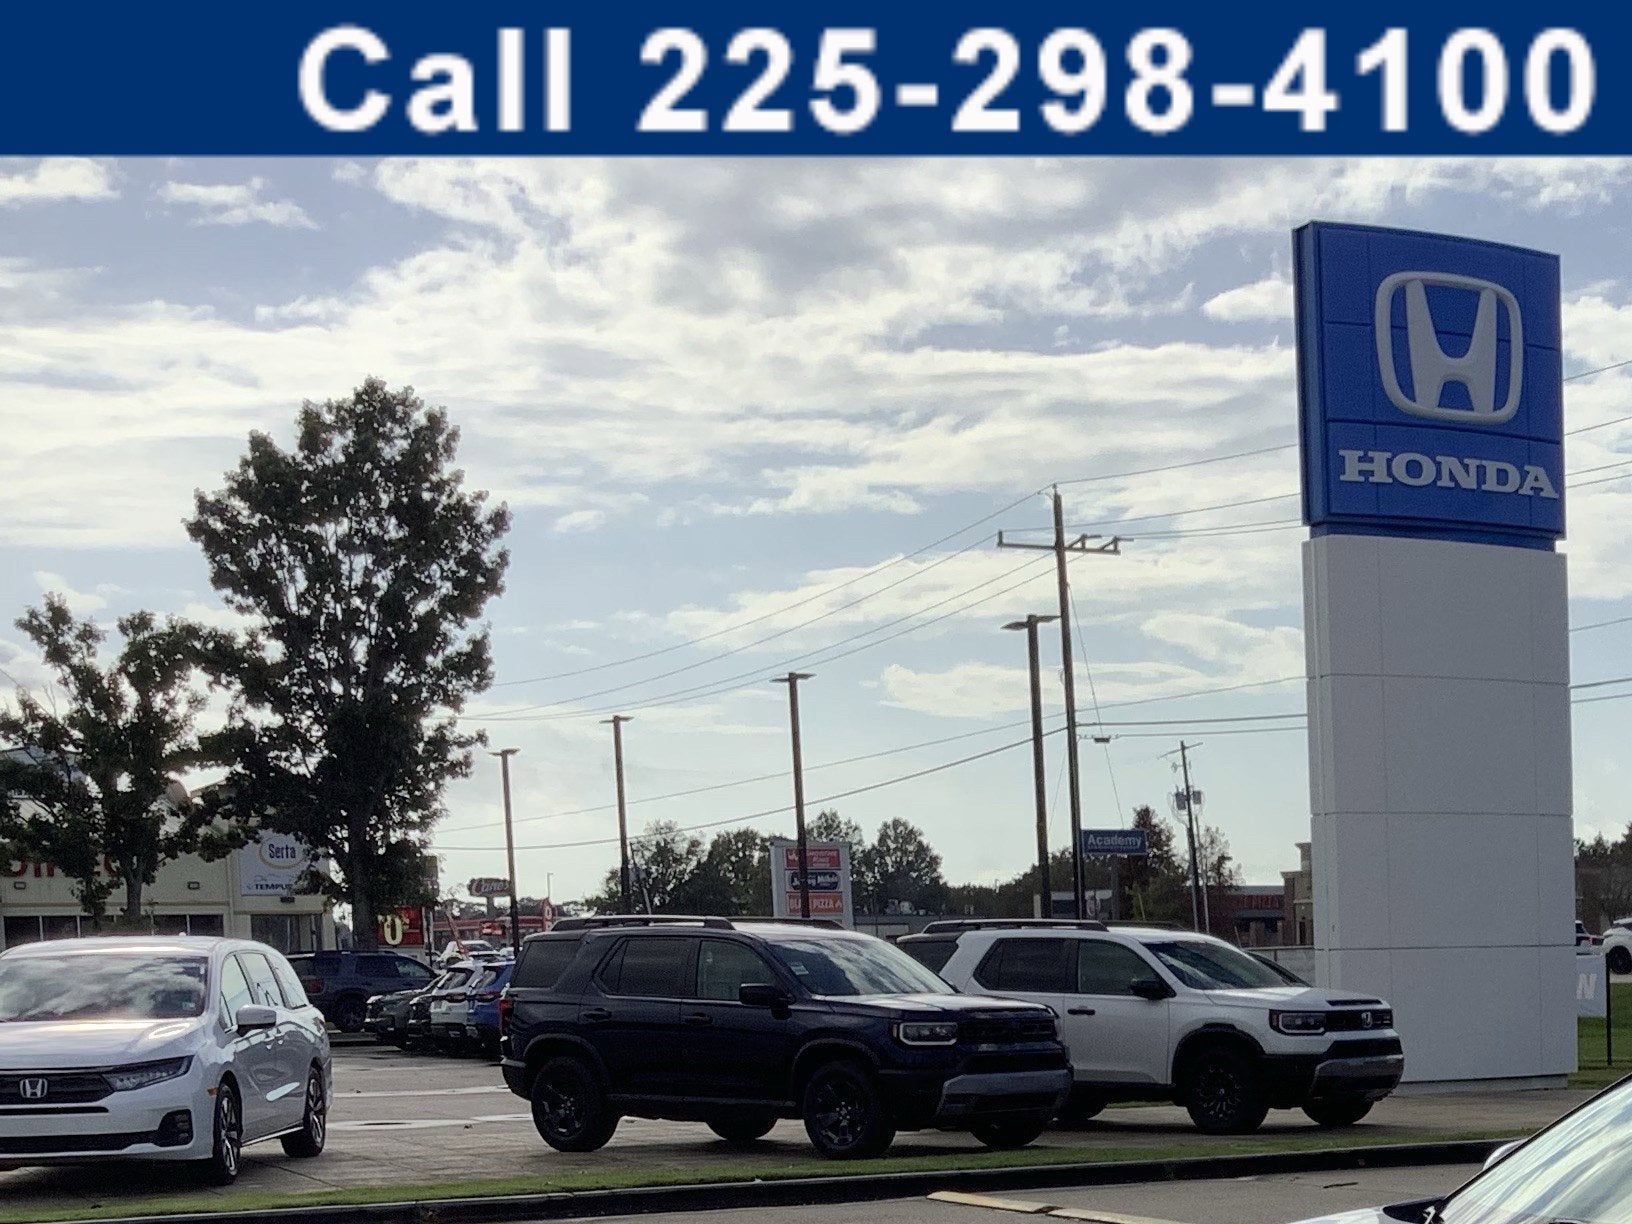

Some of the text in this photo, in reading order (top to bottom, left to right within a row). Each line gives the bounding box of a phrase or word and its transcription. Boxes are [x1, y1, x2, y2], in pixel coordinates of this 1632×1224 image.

[1339, 449, 1559, 499] HONDA
[1088, 834, 1142, 849] Academy
[268, 843, 296, 859] Serta
